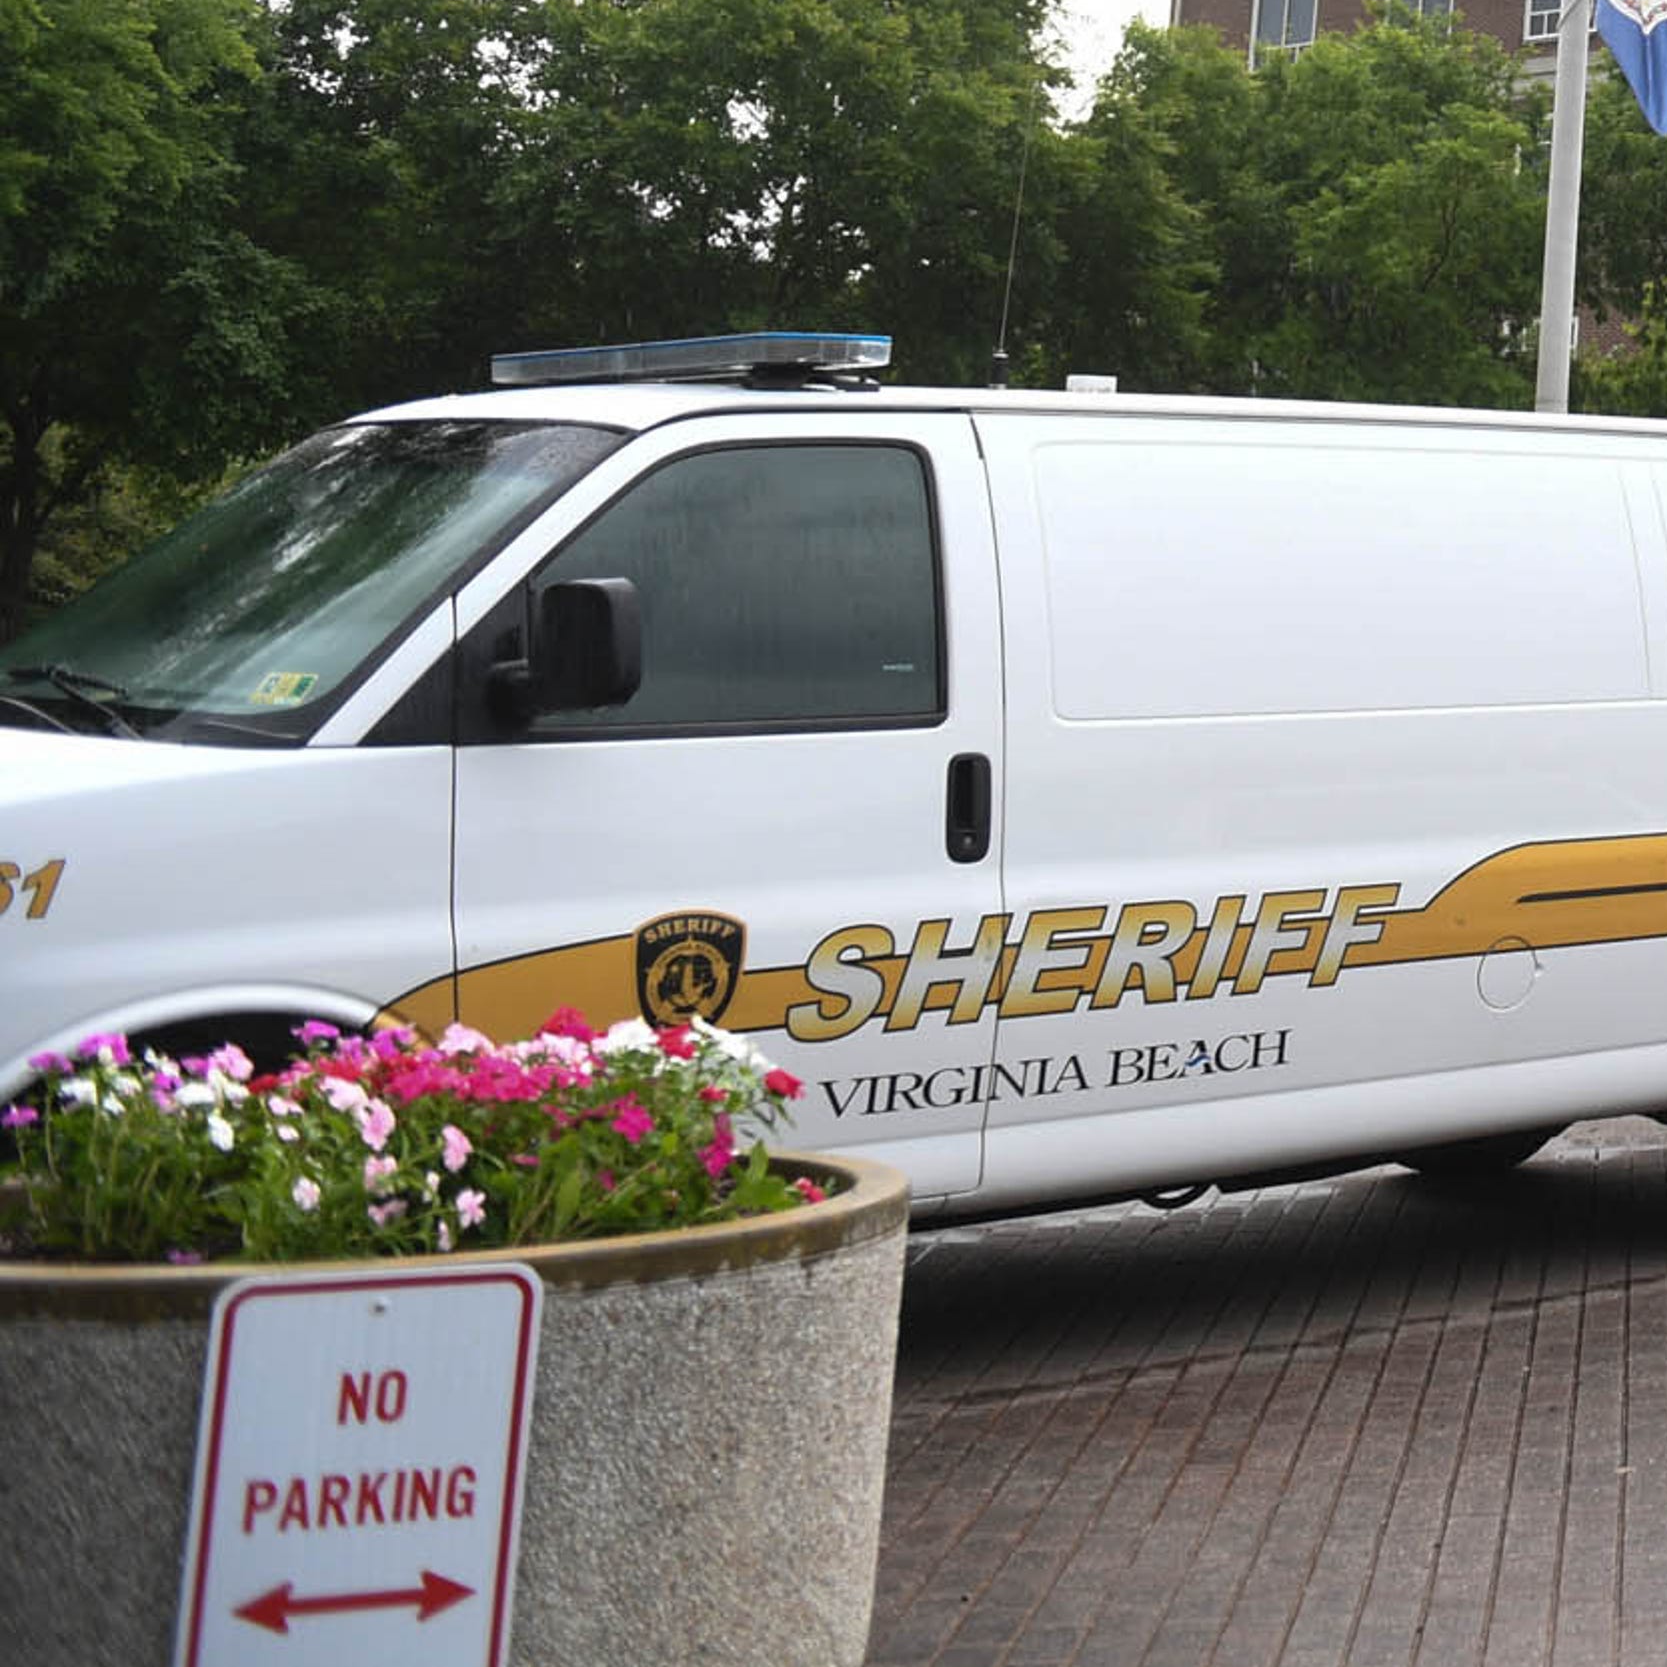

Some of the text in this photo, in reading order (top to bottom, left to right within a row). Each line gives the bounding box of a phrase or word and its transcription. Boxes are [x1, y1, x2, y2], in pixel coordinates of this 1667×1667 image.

[786, 882, 1402, 1043] SHERIFF
[818, 1028, 1293, 1118] VIRGINIA BEACH
[336, 1370, 409, 1425] NO
[242, 1465, 478, 1534] PARKING
